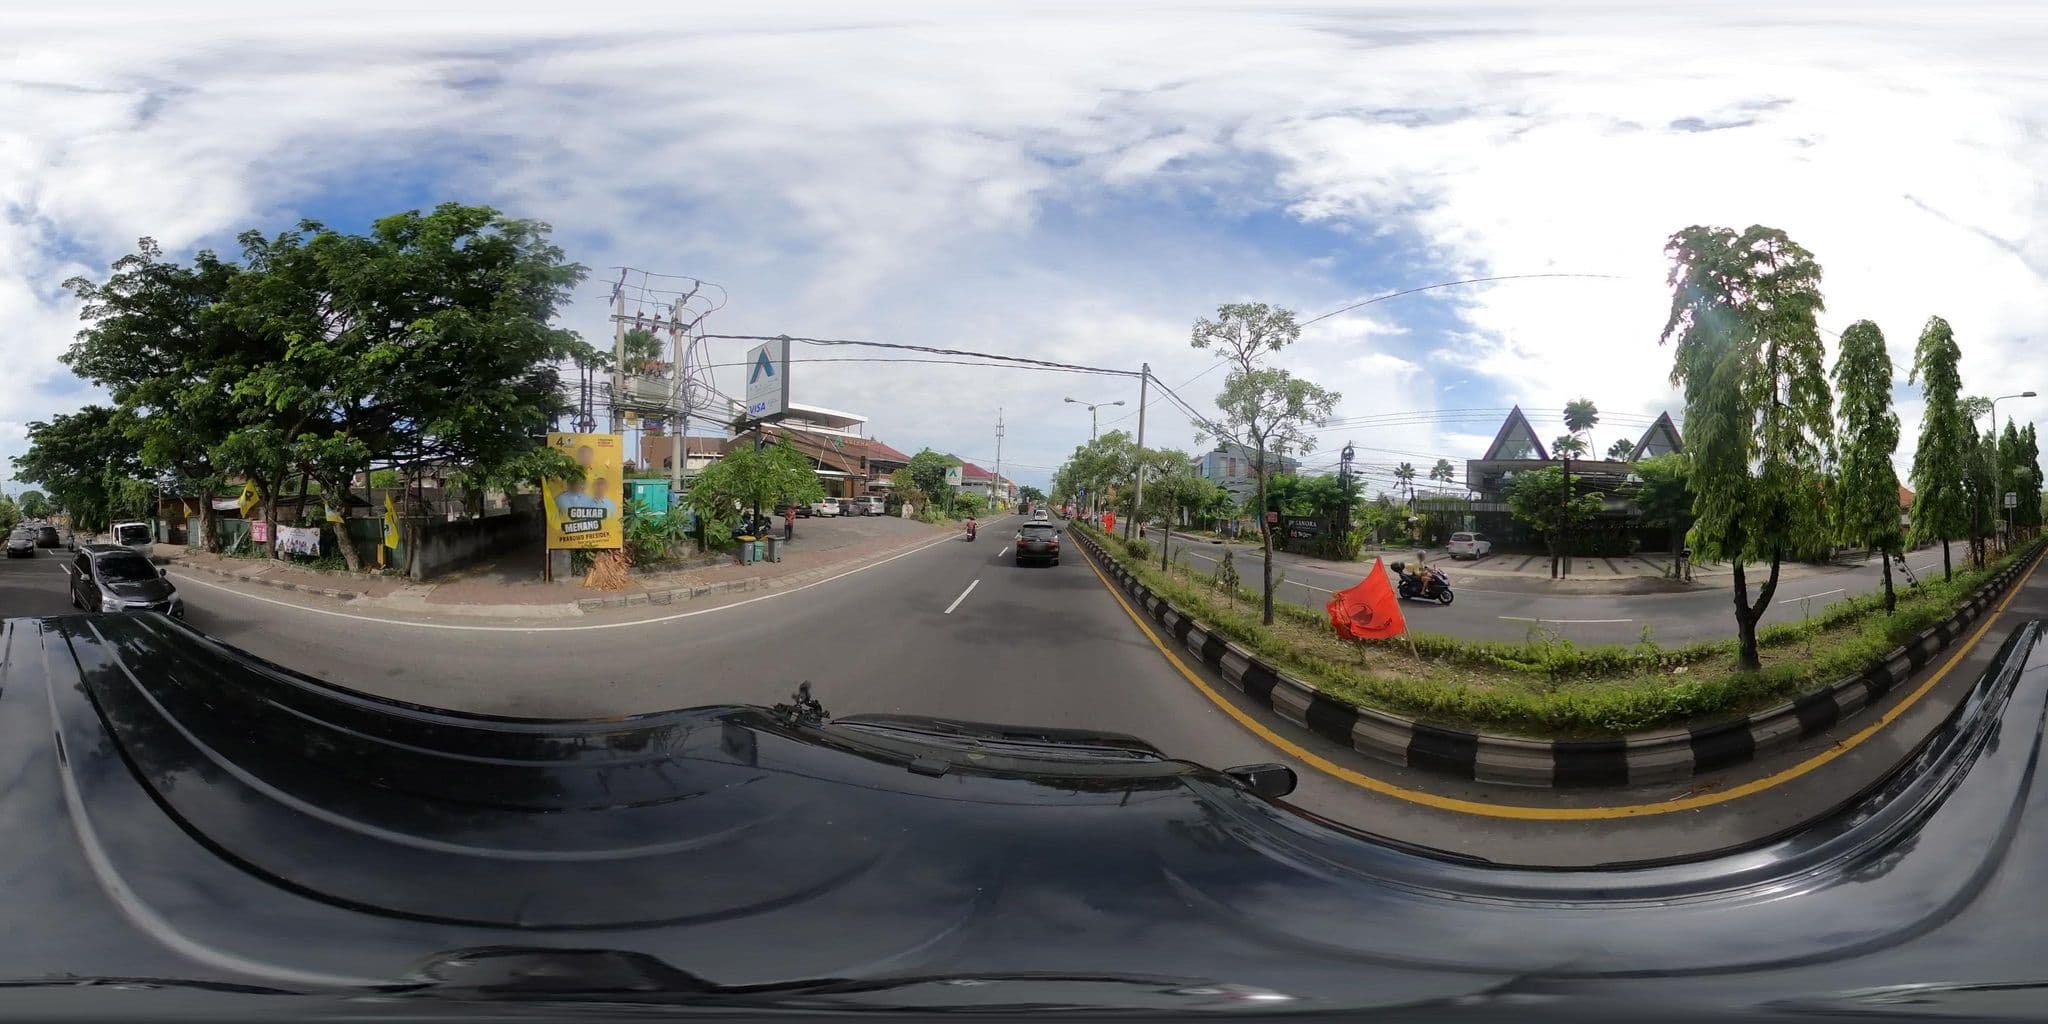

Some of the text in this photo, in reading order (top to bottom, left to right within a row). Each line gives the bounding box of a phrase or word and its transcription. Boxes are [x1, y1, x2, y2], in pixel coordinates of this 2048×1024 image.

[749, 402, 766, 414] VISA
[556, 437, 564, 447] 4
[570, 508, 604, 518] GOLKAR
[564, 520, 599, 533] MENANG
